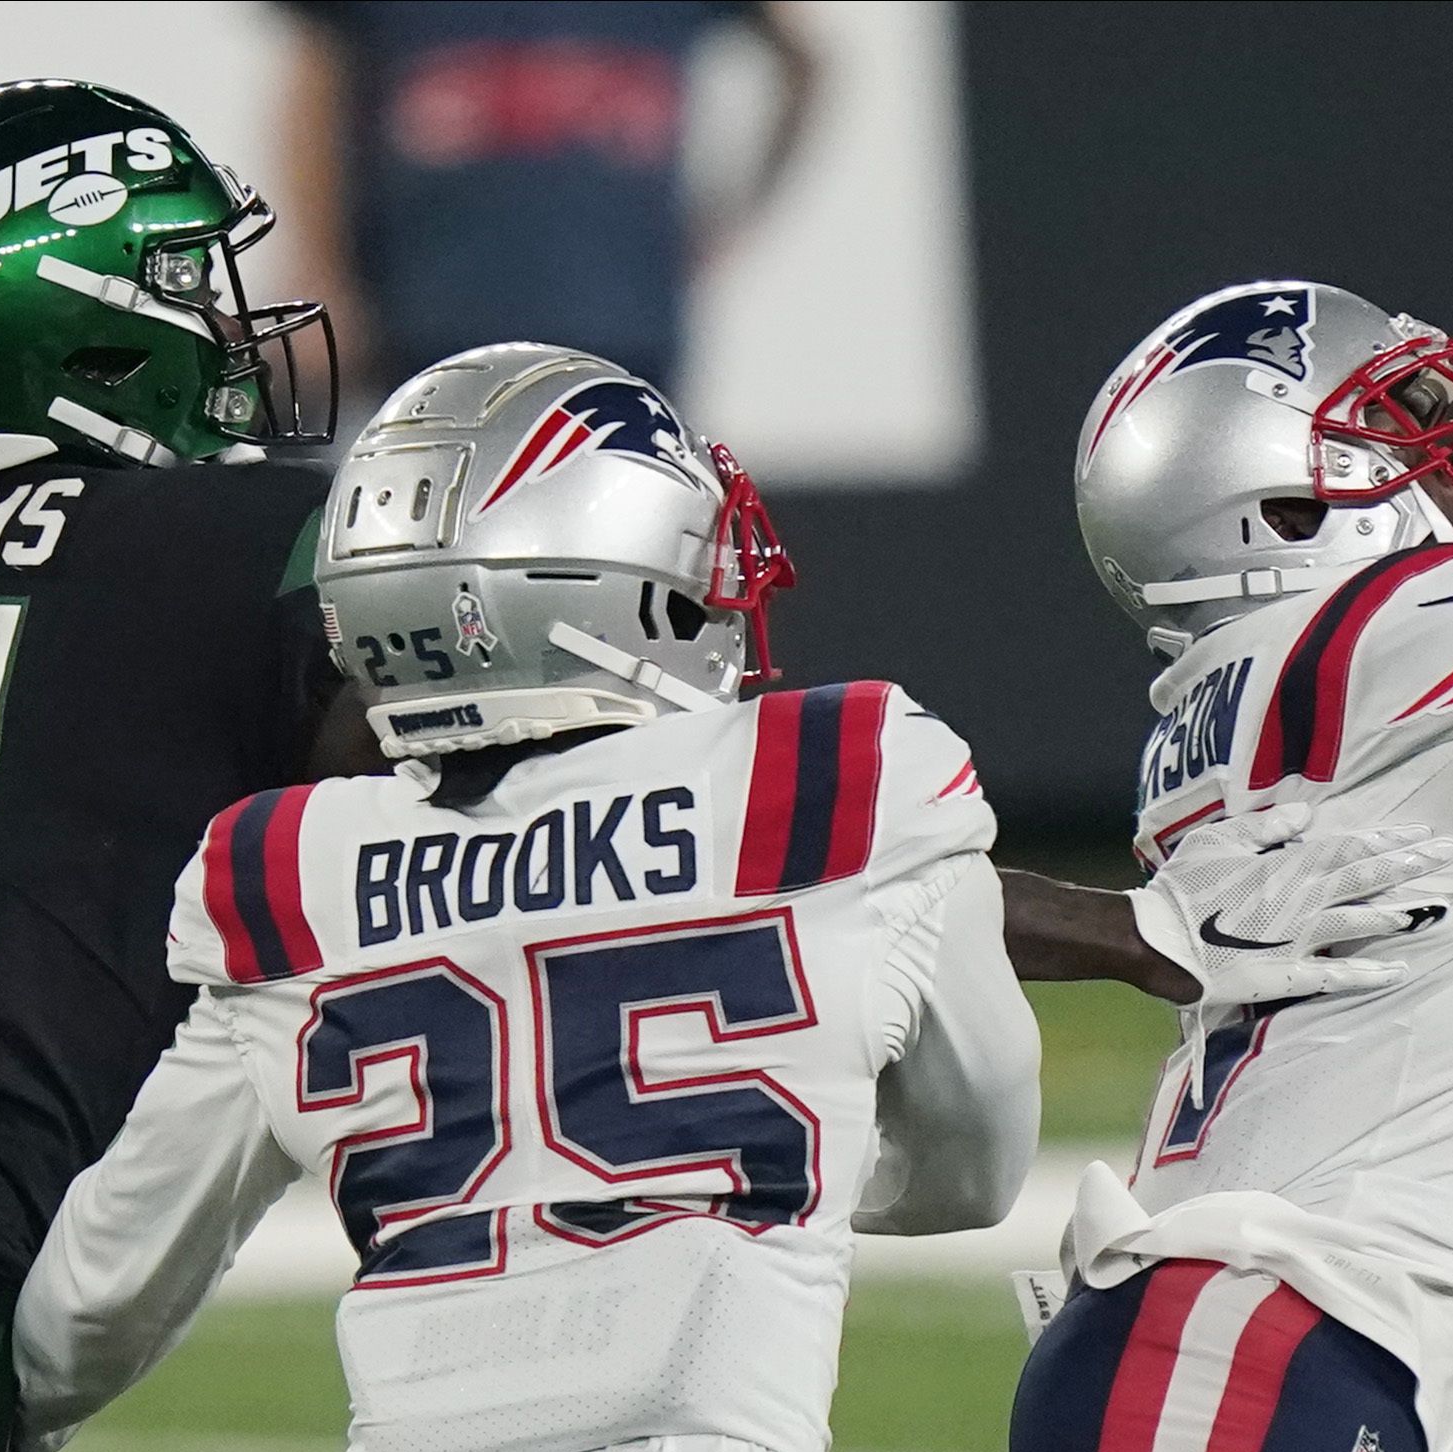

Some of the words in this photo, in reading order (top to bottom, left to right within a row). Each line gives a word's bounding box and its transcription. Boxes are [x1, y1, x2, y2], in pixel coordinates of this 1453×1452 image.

[356, 627, 455, 686] 25
[357, 785, 697, 947] BROOKS
[297, 906, 822, 1290] 25
